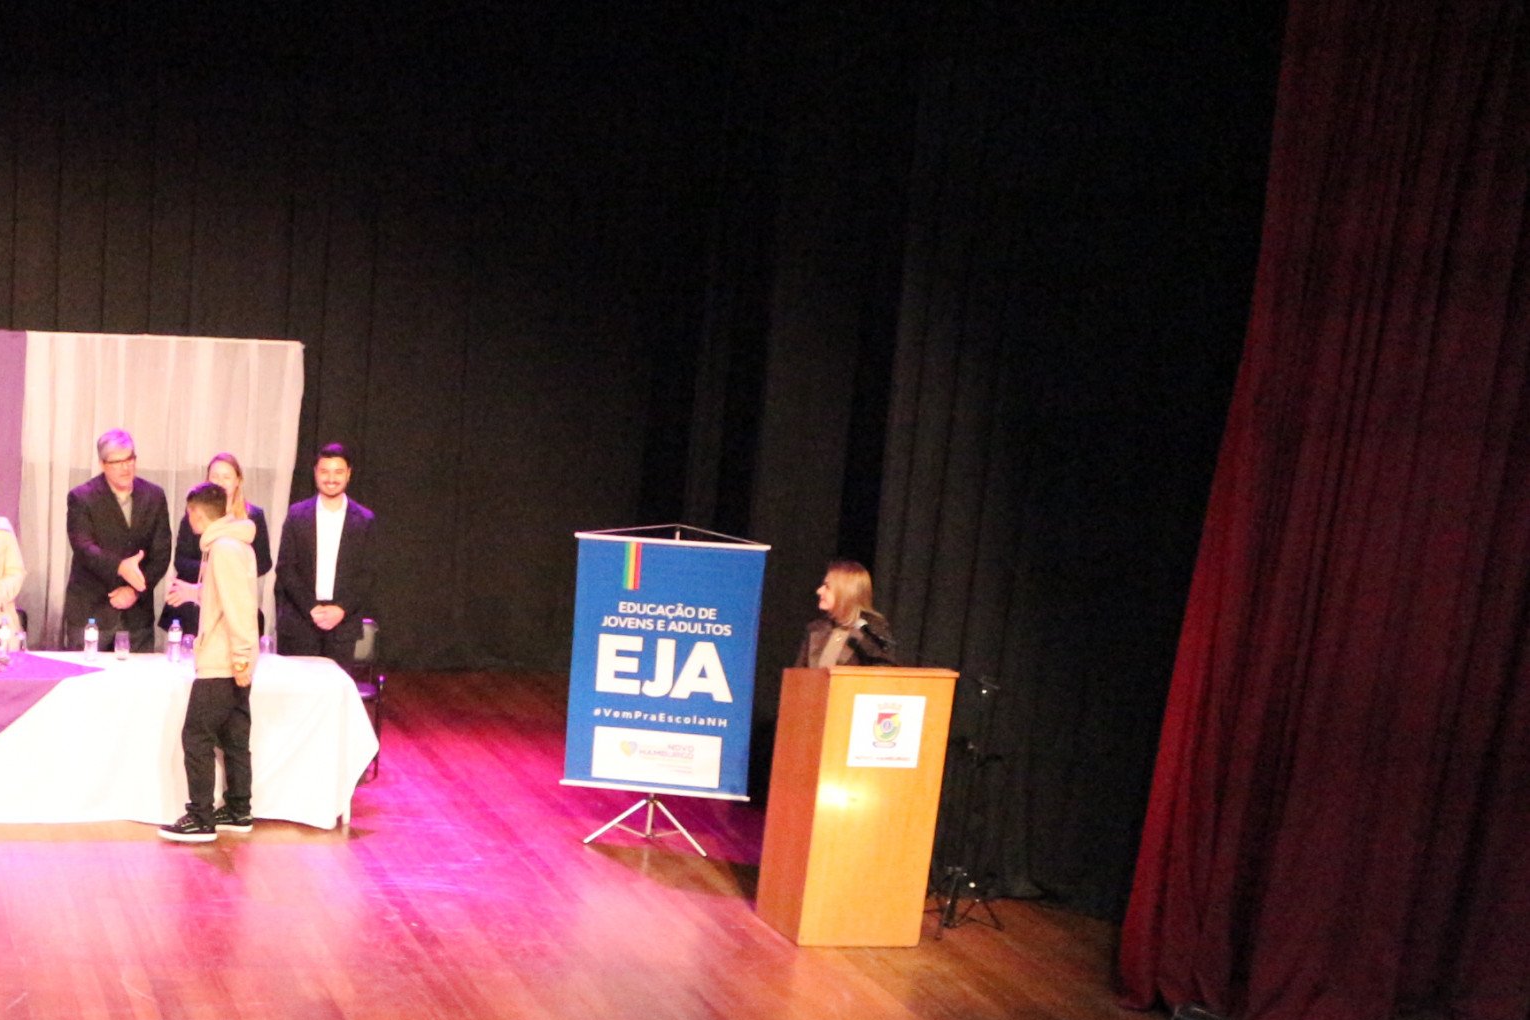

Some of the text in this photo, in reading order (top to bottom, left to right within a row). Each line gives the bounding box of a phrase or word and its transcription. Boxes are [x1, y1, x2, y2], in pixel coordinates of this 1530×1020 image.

[618, 601, 717, 620] EDUCAÇÃO DE
[601, 615, 733, 637] JOVENS E ADULTOS
[595, 633, 733, 704] EJA
[593, 707, 728, 728] #VemPraEscolaNH
